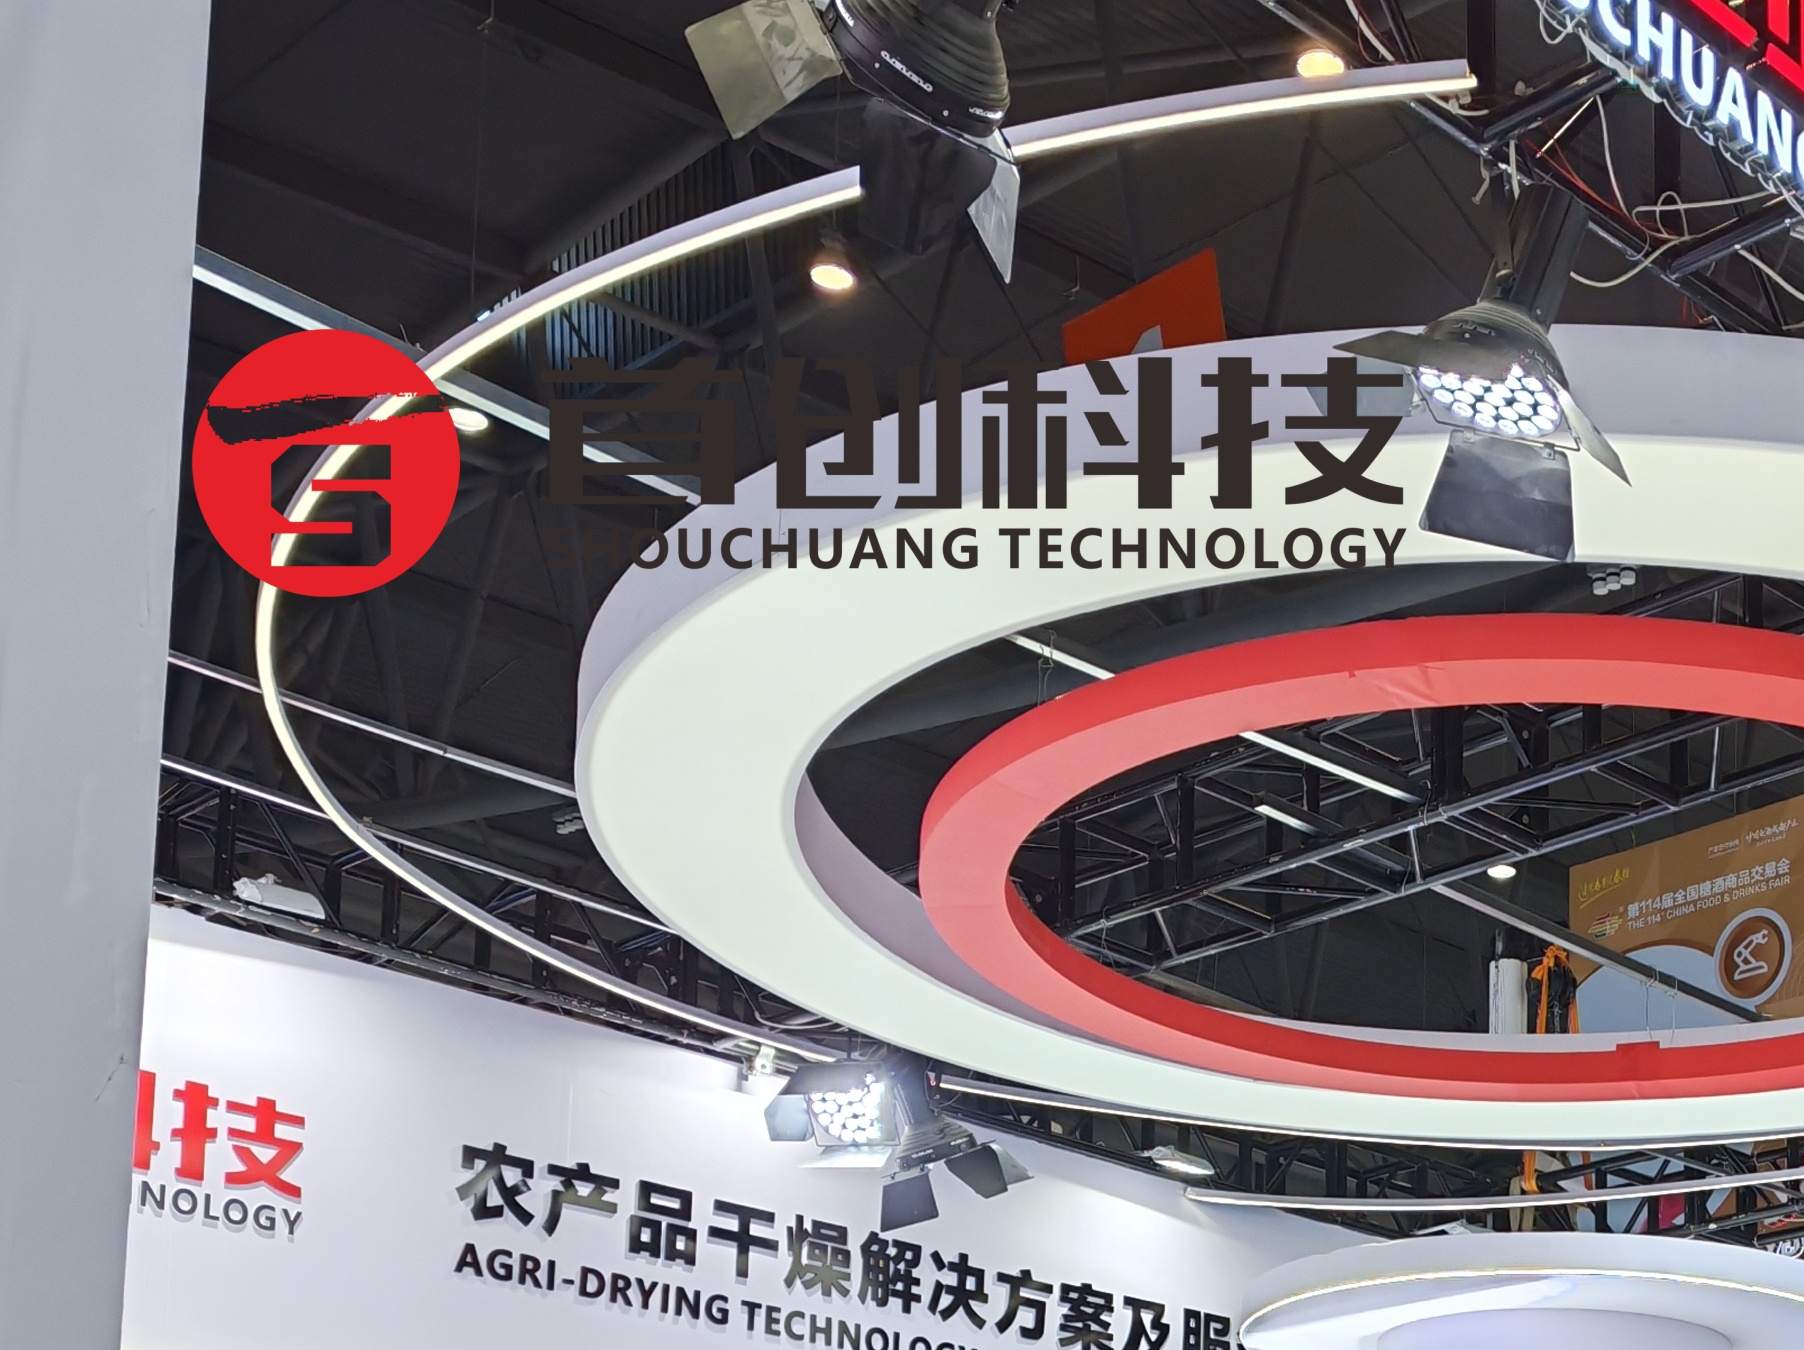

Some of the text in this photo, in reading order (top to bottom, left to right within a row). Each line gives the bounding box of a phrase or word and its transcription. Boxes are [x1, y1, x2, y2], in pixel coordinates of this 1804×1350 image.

[1627, 917, 1646, 930] THE
[1666, 905, 1696, 920] CHINA
[1697, 897, 1722, 910] FOOD
[1723, 893, 1731, 904] &
[1732, 883, 1768, 901] DRINKS
[1768, 875, 1792, 890] FAIR
[139, 1179, 303, 1237] NOLOGY
[454, 1242, 731, 1327] AGRI-DRYING
